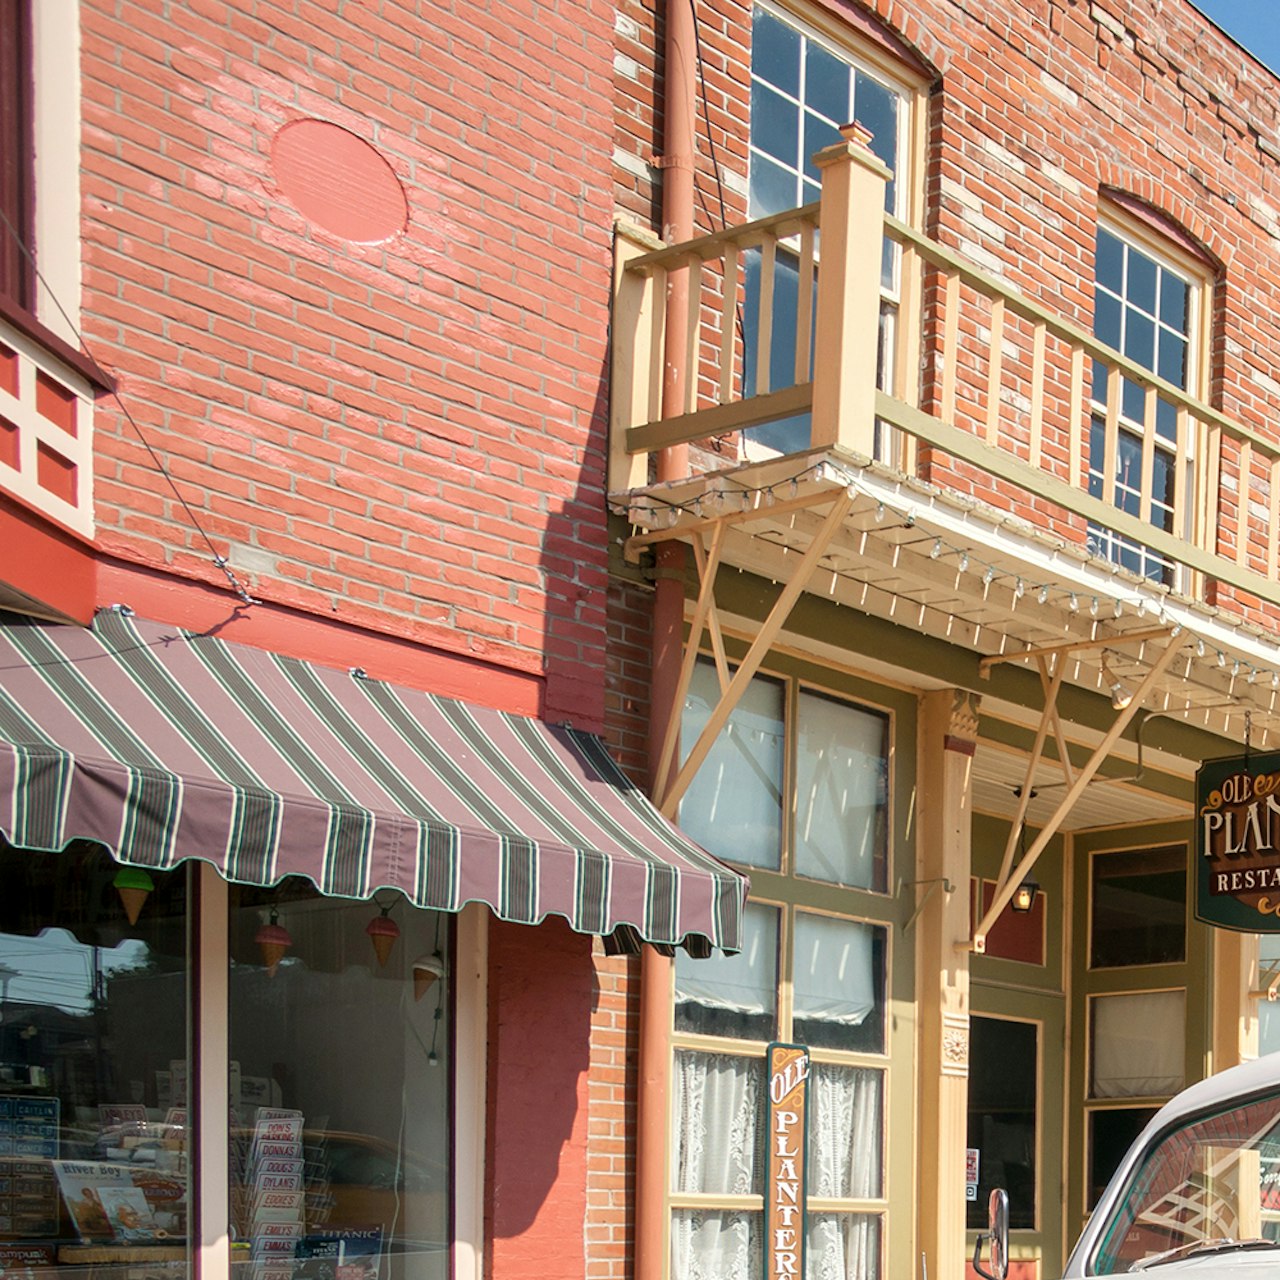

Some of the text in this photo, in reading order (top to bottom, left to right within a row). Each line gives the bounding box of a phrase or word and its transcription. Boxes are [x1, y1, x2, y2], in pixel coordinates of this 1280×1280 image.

[1222, 775, 1251, 804] OLE
[770, 1055, 810, 1104] OLE
[62, 1163, 121, 1177] River Boy
[321, 1230, 377, 1239] TITANIC
[0, 1249, 48, 1260] ampunk
